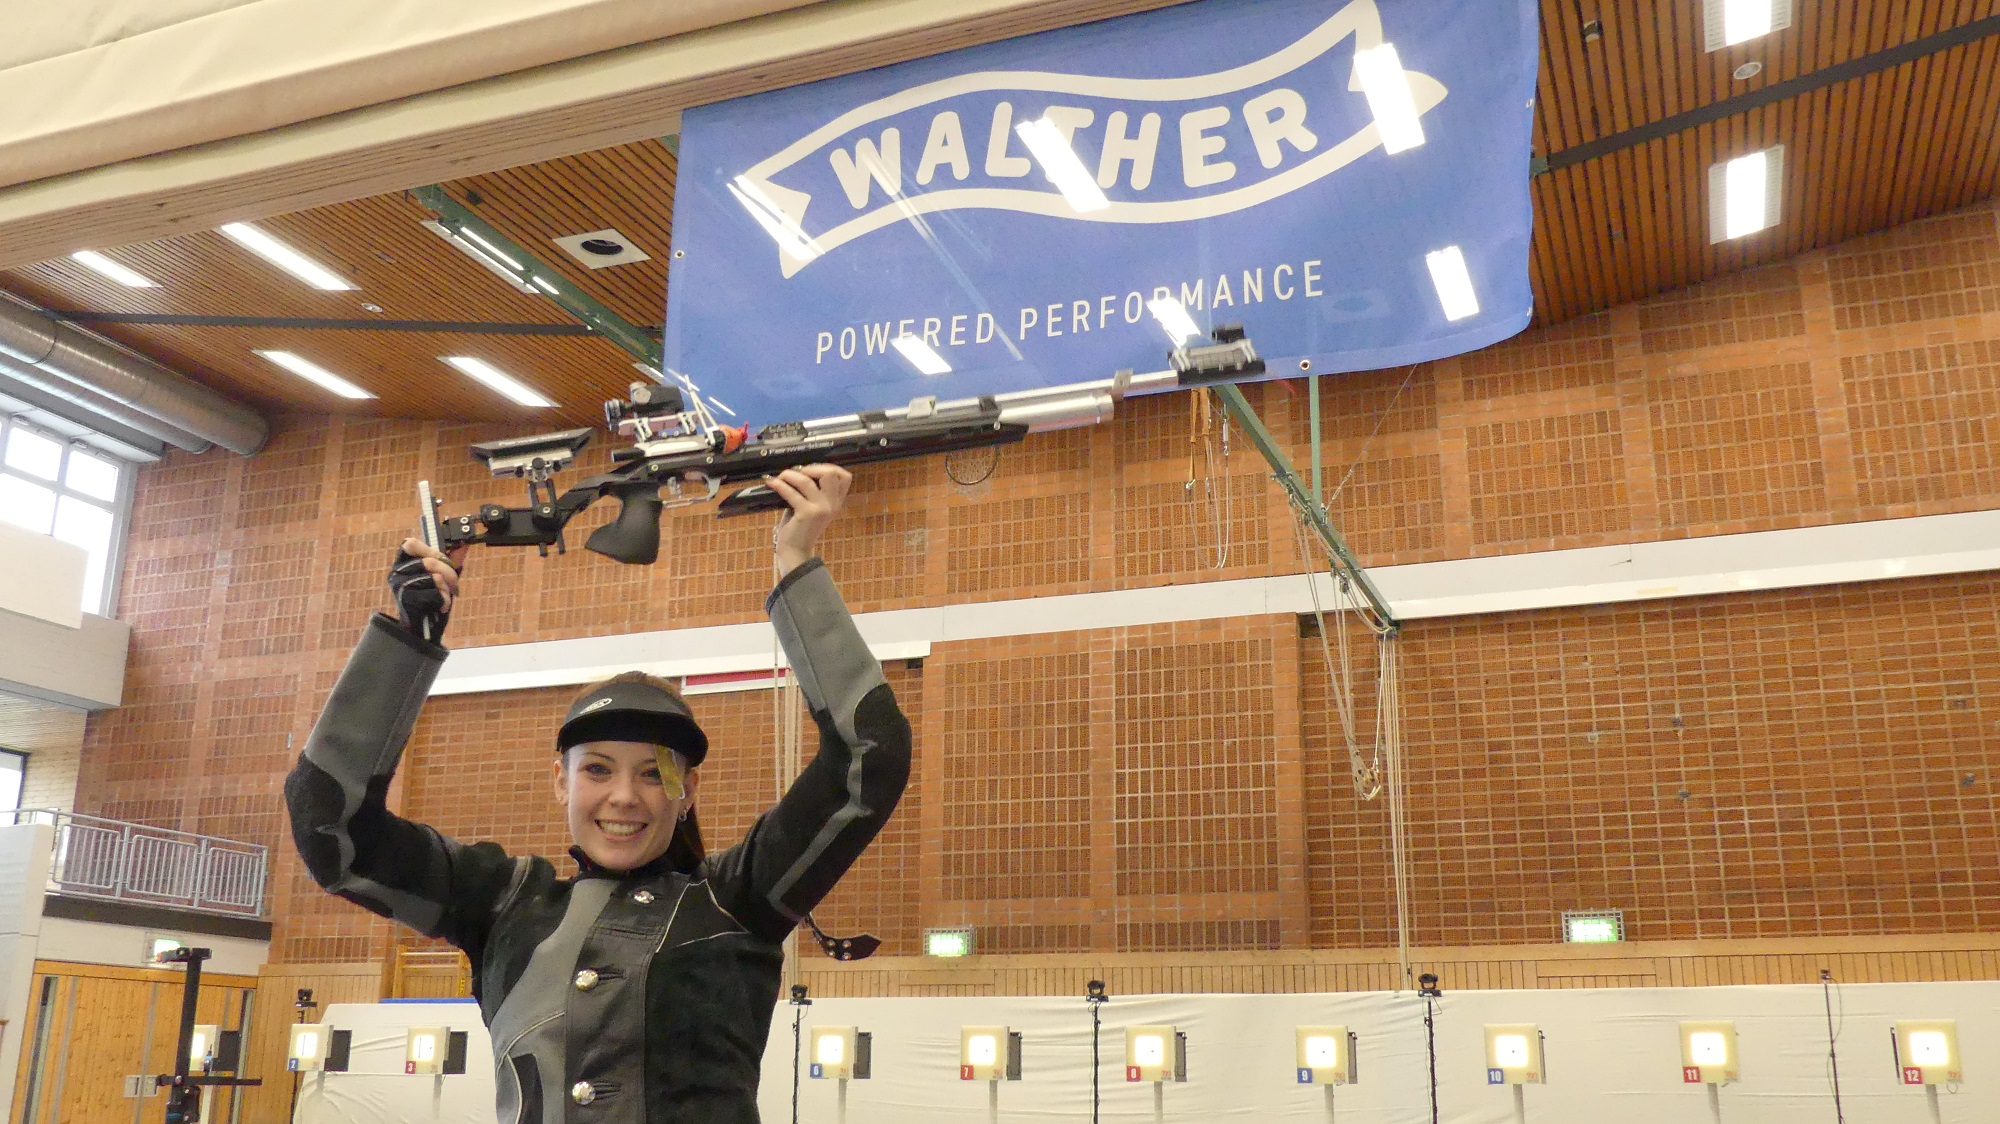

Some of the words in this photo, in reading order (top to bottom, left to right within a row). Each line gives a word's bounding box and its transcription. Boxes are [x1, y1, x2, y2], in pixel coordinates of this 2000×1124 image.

[830, 88, 1318, 209] WALTHER
[816, 312, 995, 364] POWERED
[291, 1059, 297, 1069] 2
[408, 1062, 414, 1072] 3
[963, 1067, 969, 1078] 7
[1302, 1070, 1308, 1081] 9
[1489, 1070, 1501, 1082] 10
[1686, 1069, 1698, 1081] 11
[1905, 1069, 1920, 1082] 12
